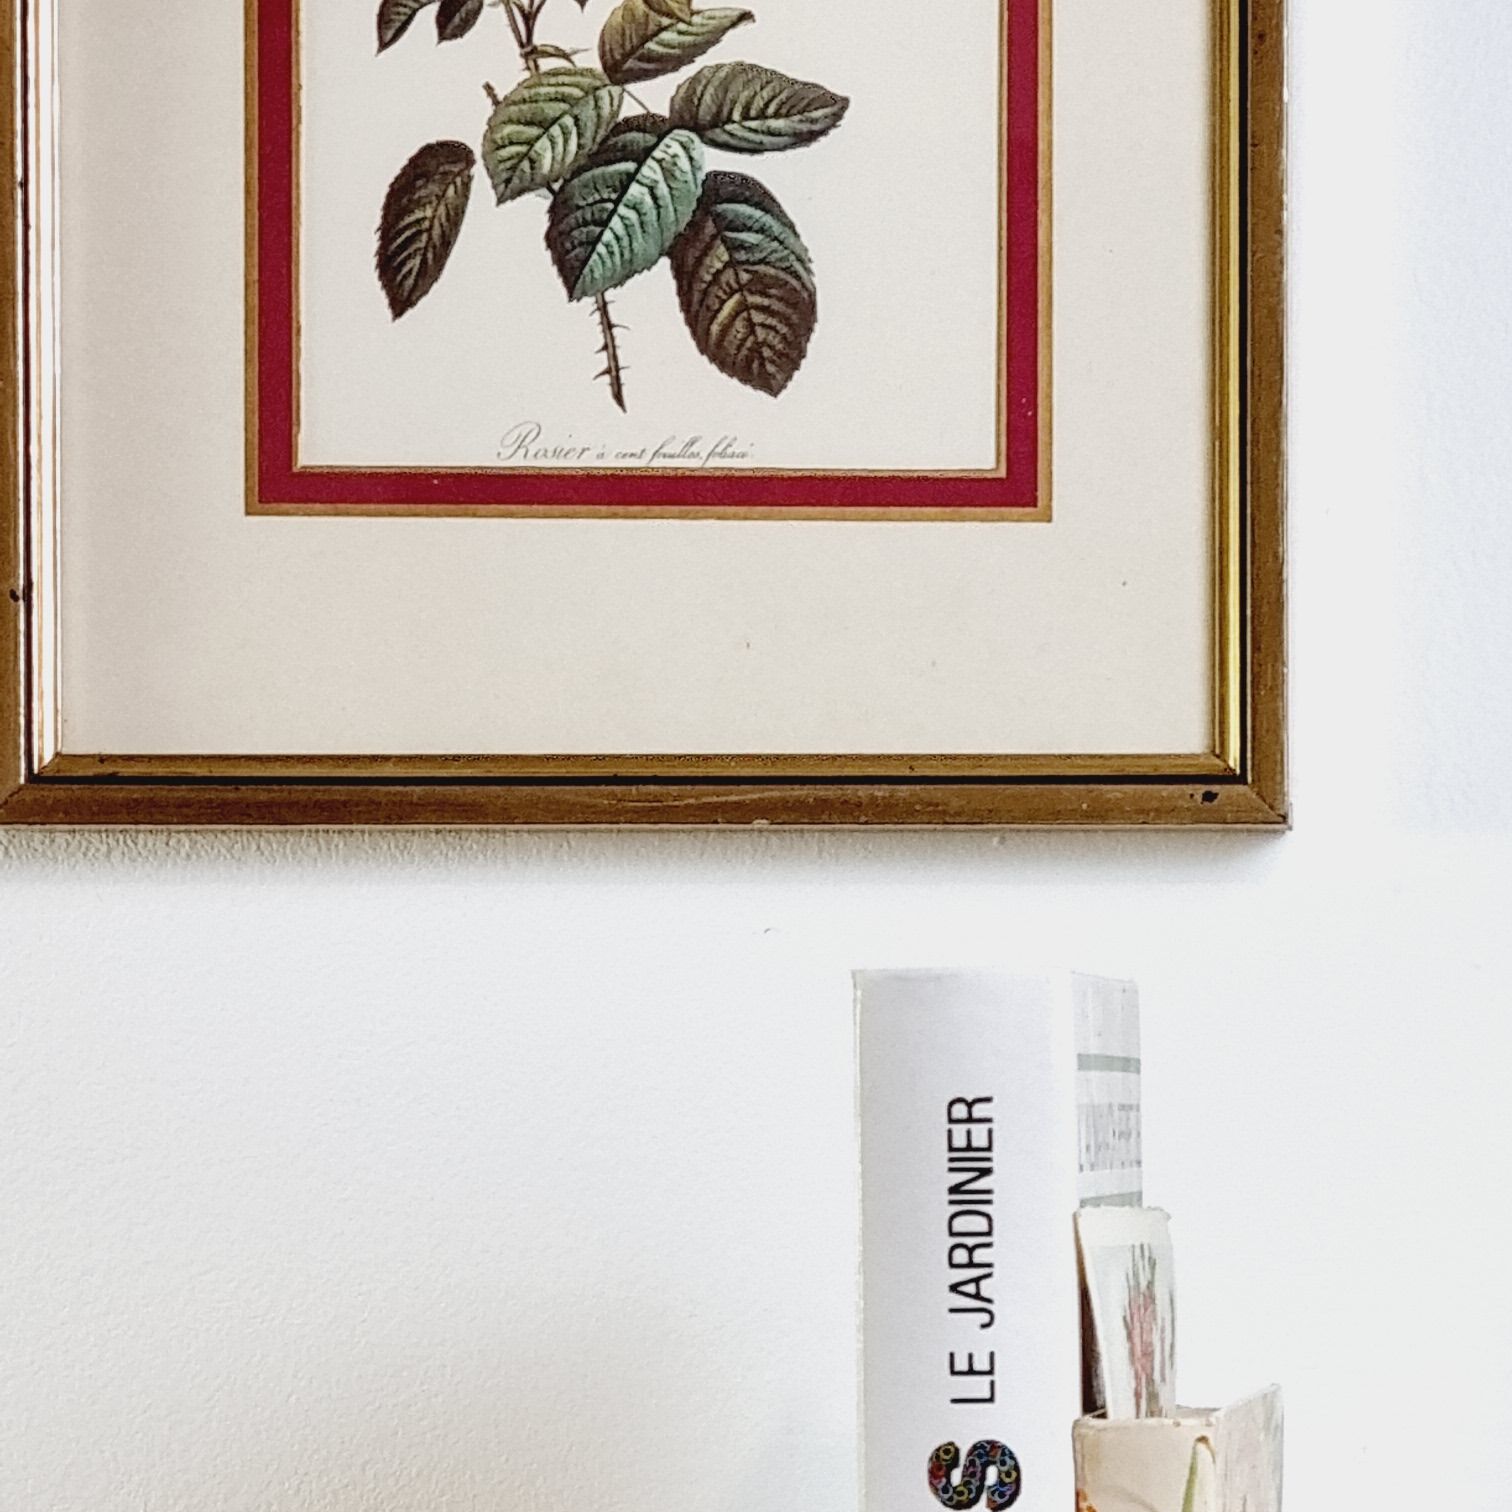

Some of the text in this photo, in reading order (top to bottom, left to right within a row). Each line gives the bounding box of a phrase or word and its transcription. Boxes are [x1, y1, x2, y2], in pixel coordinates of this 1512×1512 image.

[496, 420, 591, 461] Rosier
[946, 1096, 994, 1330] JARDINIER
[948, 1350, 995, 1405] LE
